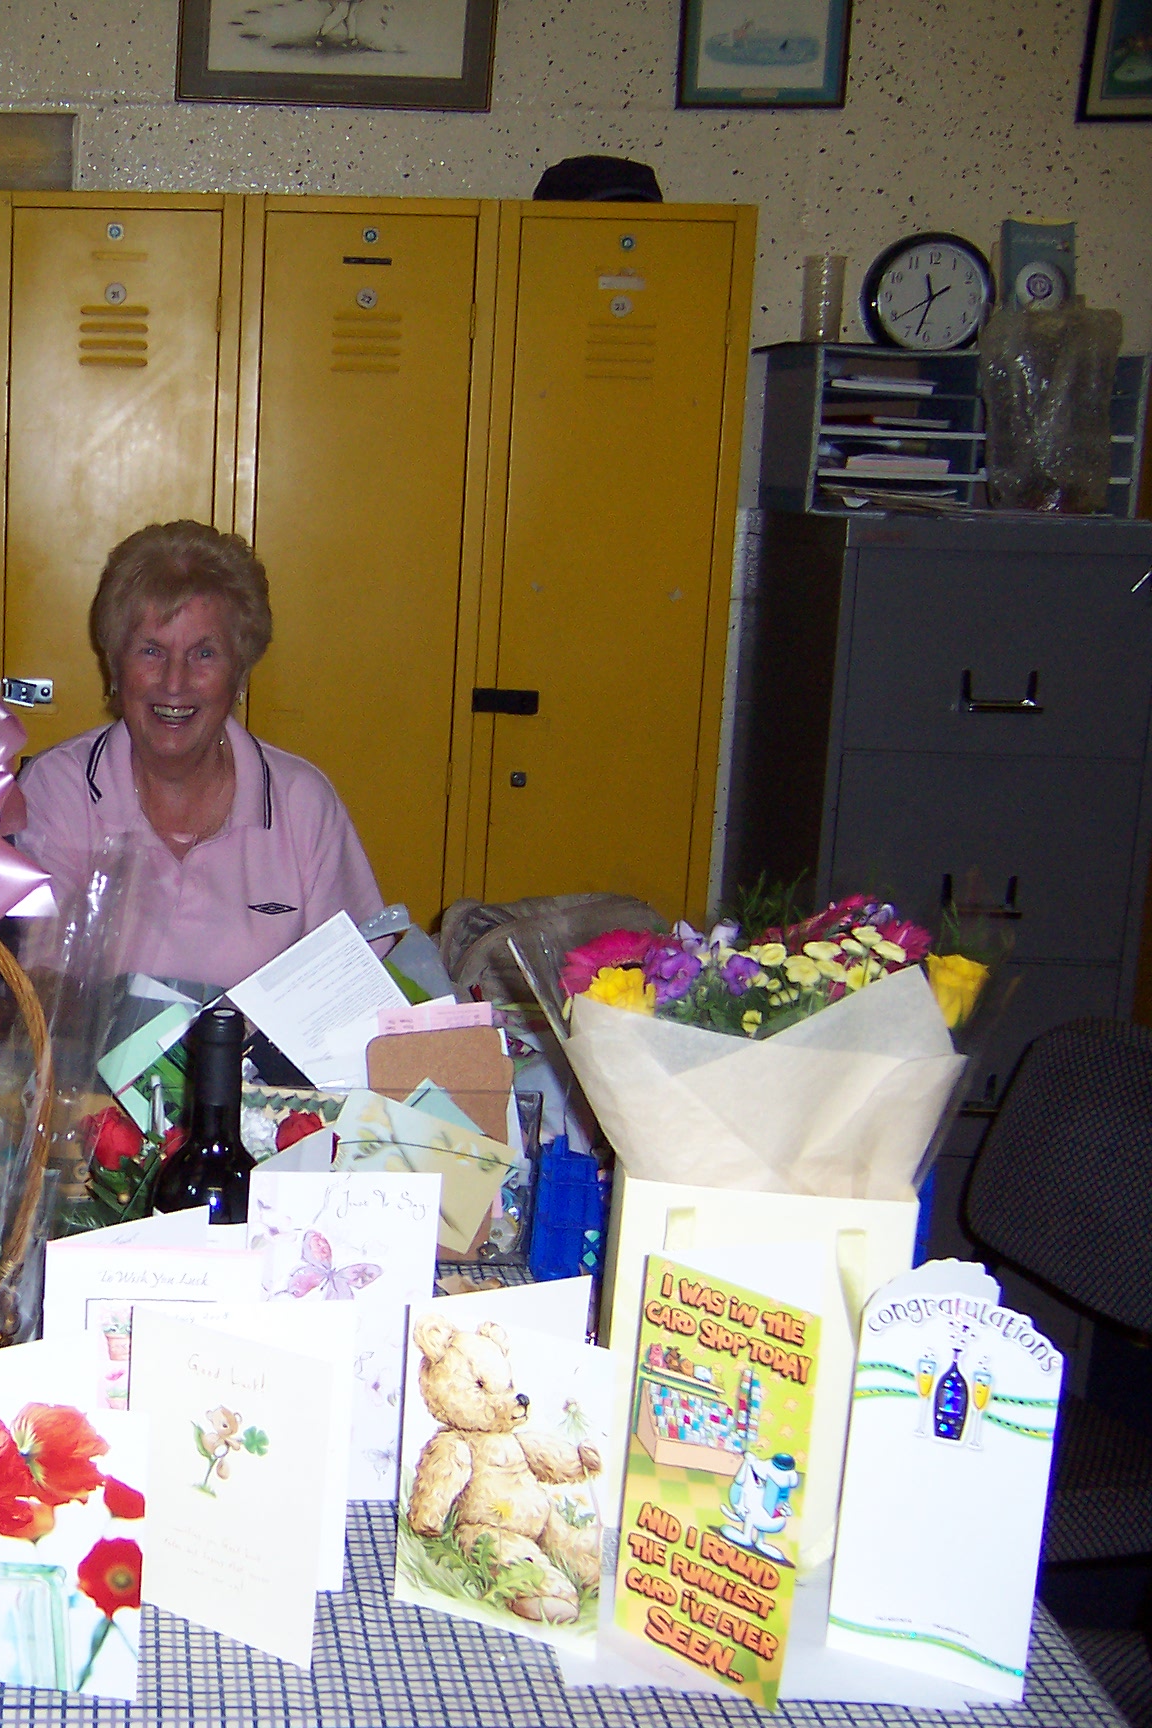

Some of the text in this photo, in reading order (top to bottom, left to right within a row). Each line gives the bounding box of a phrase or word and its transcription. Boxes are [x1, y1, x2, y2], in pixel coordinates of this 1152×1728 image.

[908, 256, 919, 270] 11
[929, 252, 942, 265] 12
[952, 257, 958, 271] 1
[891, 271, 903, 284] 10
[965, 271, 973, 285] 2
[885, 291, 893, 303] 9
[905, 325, 912, 338] 7
[922, 330, 930, 343] 6
[115, 1270, 148, 1284] Wish
[179, 1271, 209, 1286] Luck
[661, 1273, 674, 1298] I
[679, 1278, 727, 1316] WAS
[762, 1311, 805, 1346] THE
[645, 1301, 812, 1385] CARD SHOP TODAY
[628, 1533, 667, 1567] THE
[637, 1502, 781, 1590] AND I FOUND
[625, 1567, 678, 1606] CARD
[715, 1610, 779, 1661] EVER
